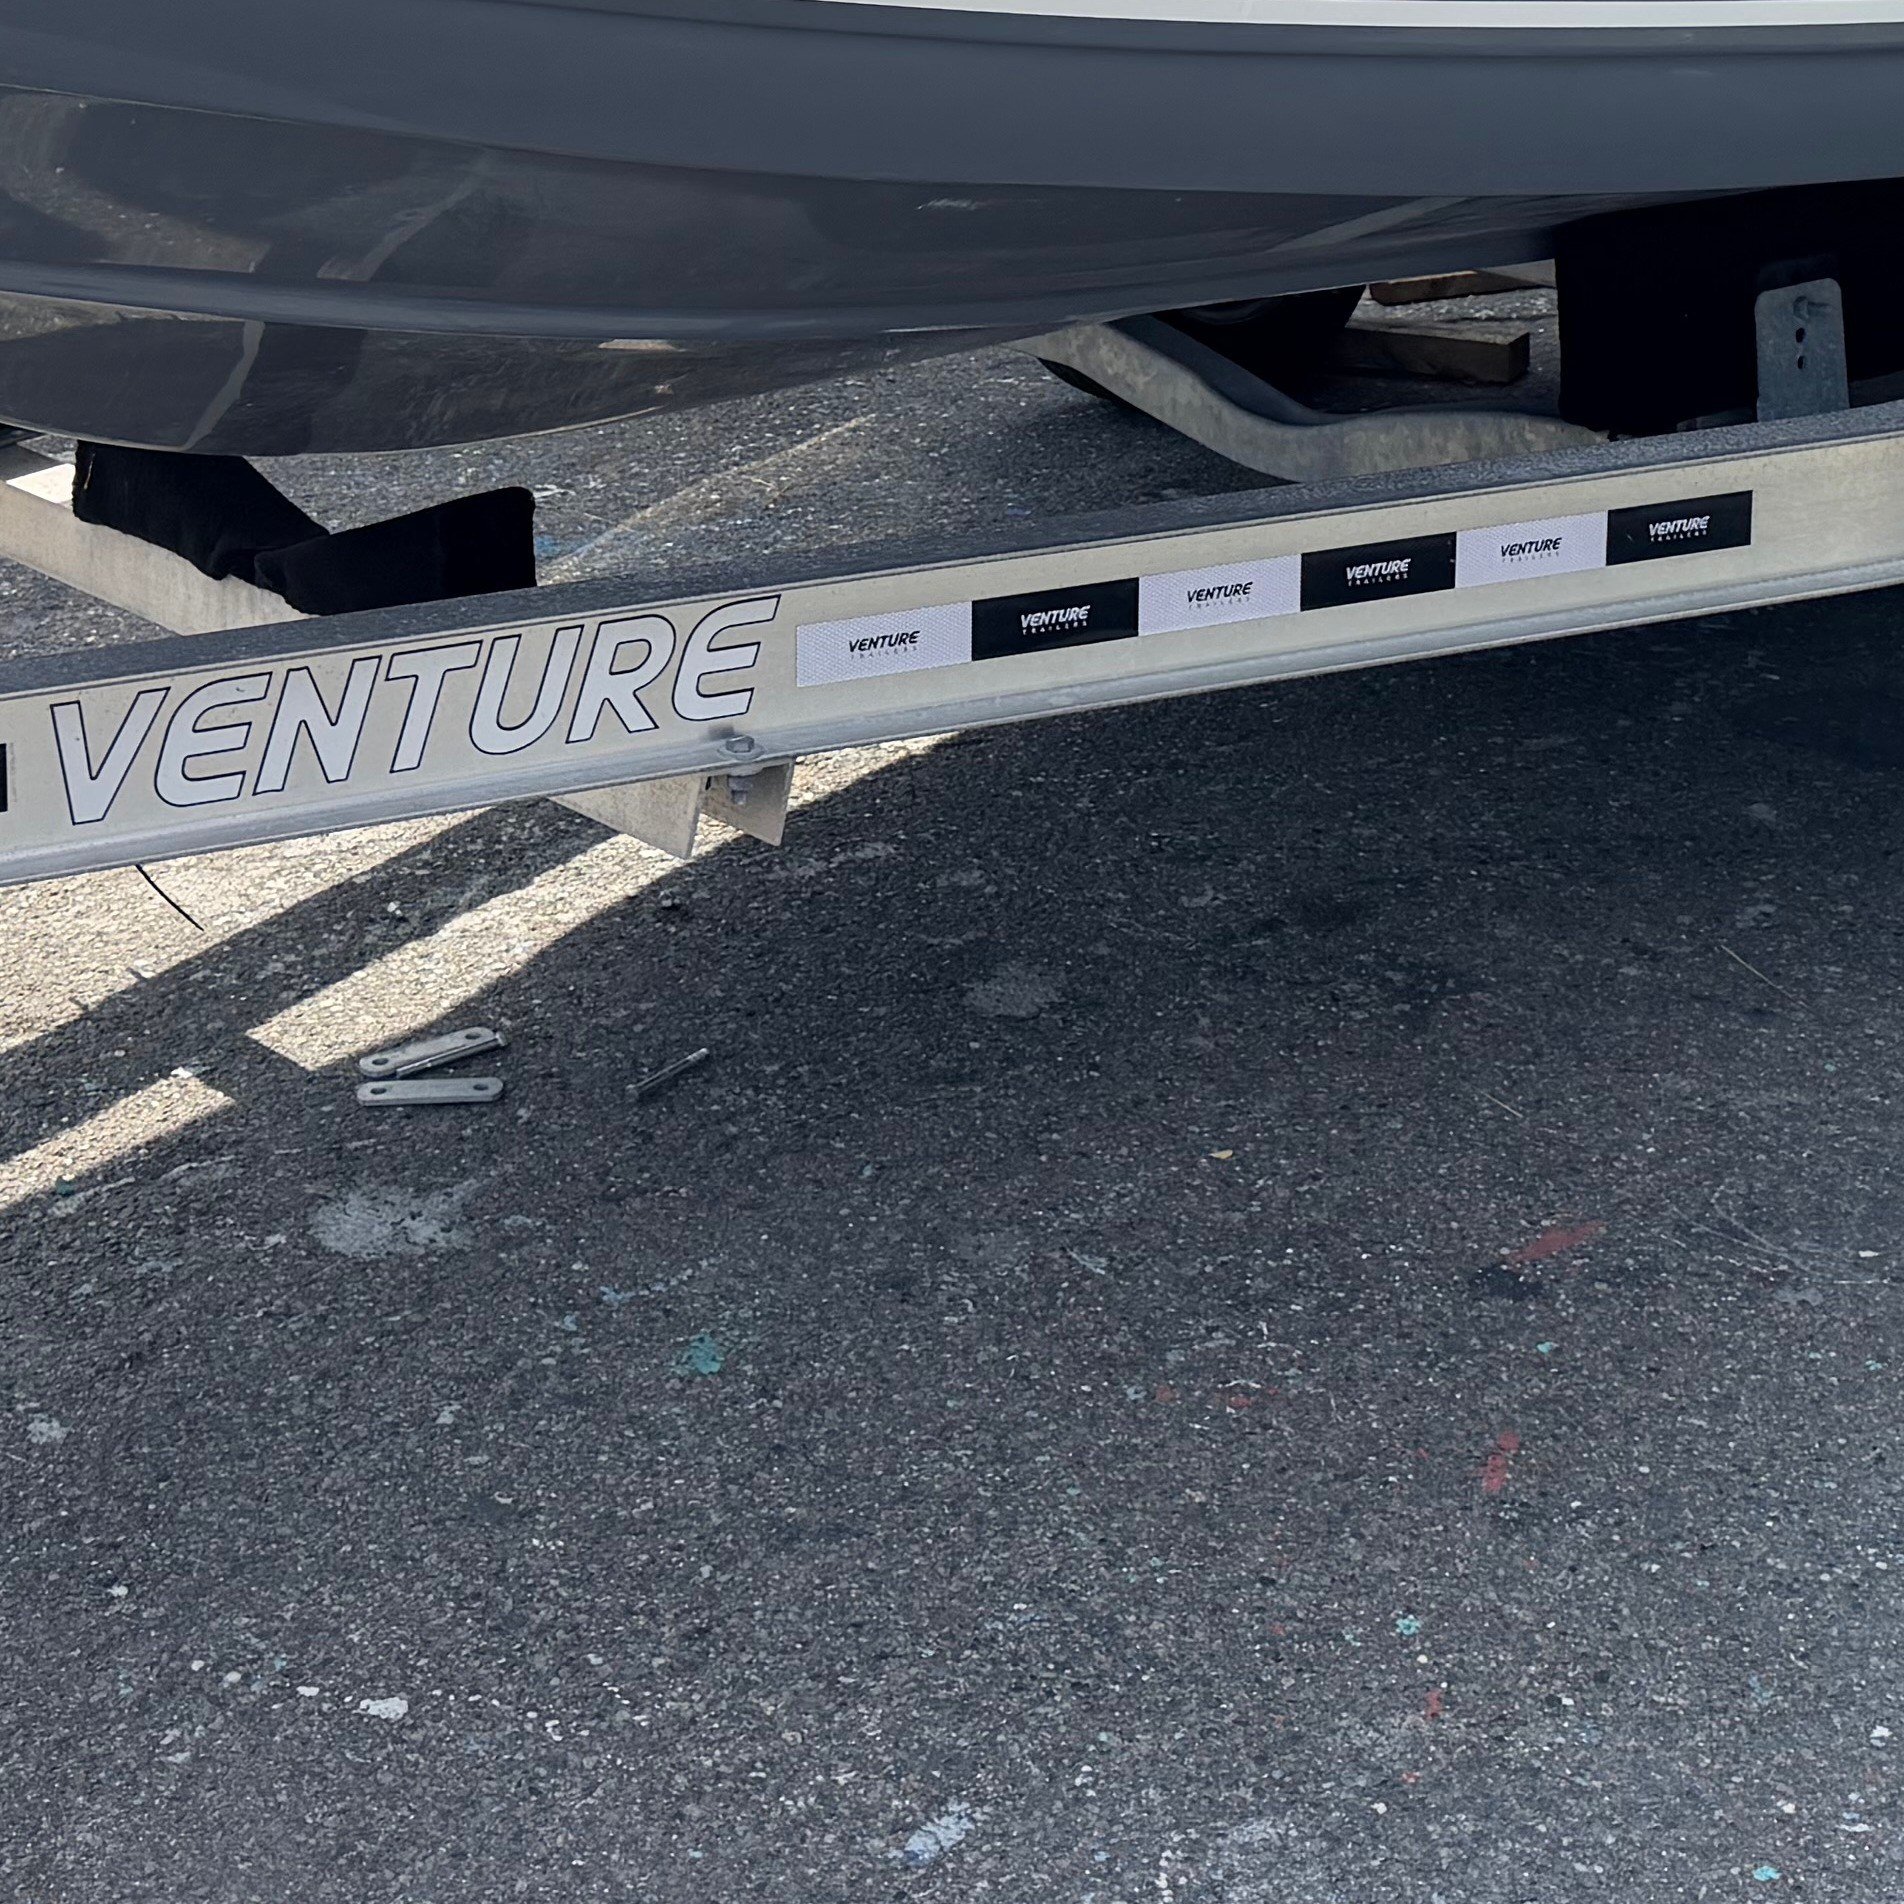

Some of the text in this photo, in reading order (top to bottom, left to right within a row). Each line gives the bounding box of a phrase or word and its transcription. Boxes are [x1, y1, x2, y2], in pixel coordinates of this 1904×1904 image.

[1649, 515, 1710, 536] VENTURE
[1501, 537, 1562, 557] VENTURE
[1346, 558, 1411, 580] VENTURE
[1187, 581, 1253, 602] VENTURE
[1021, 605, 1091, 628] VENTURE
[849, 631, 920, 652] VENTURE
[50, 594, 781, 826] VENTURE
